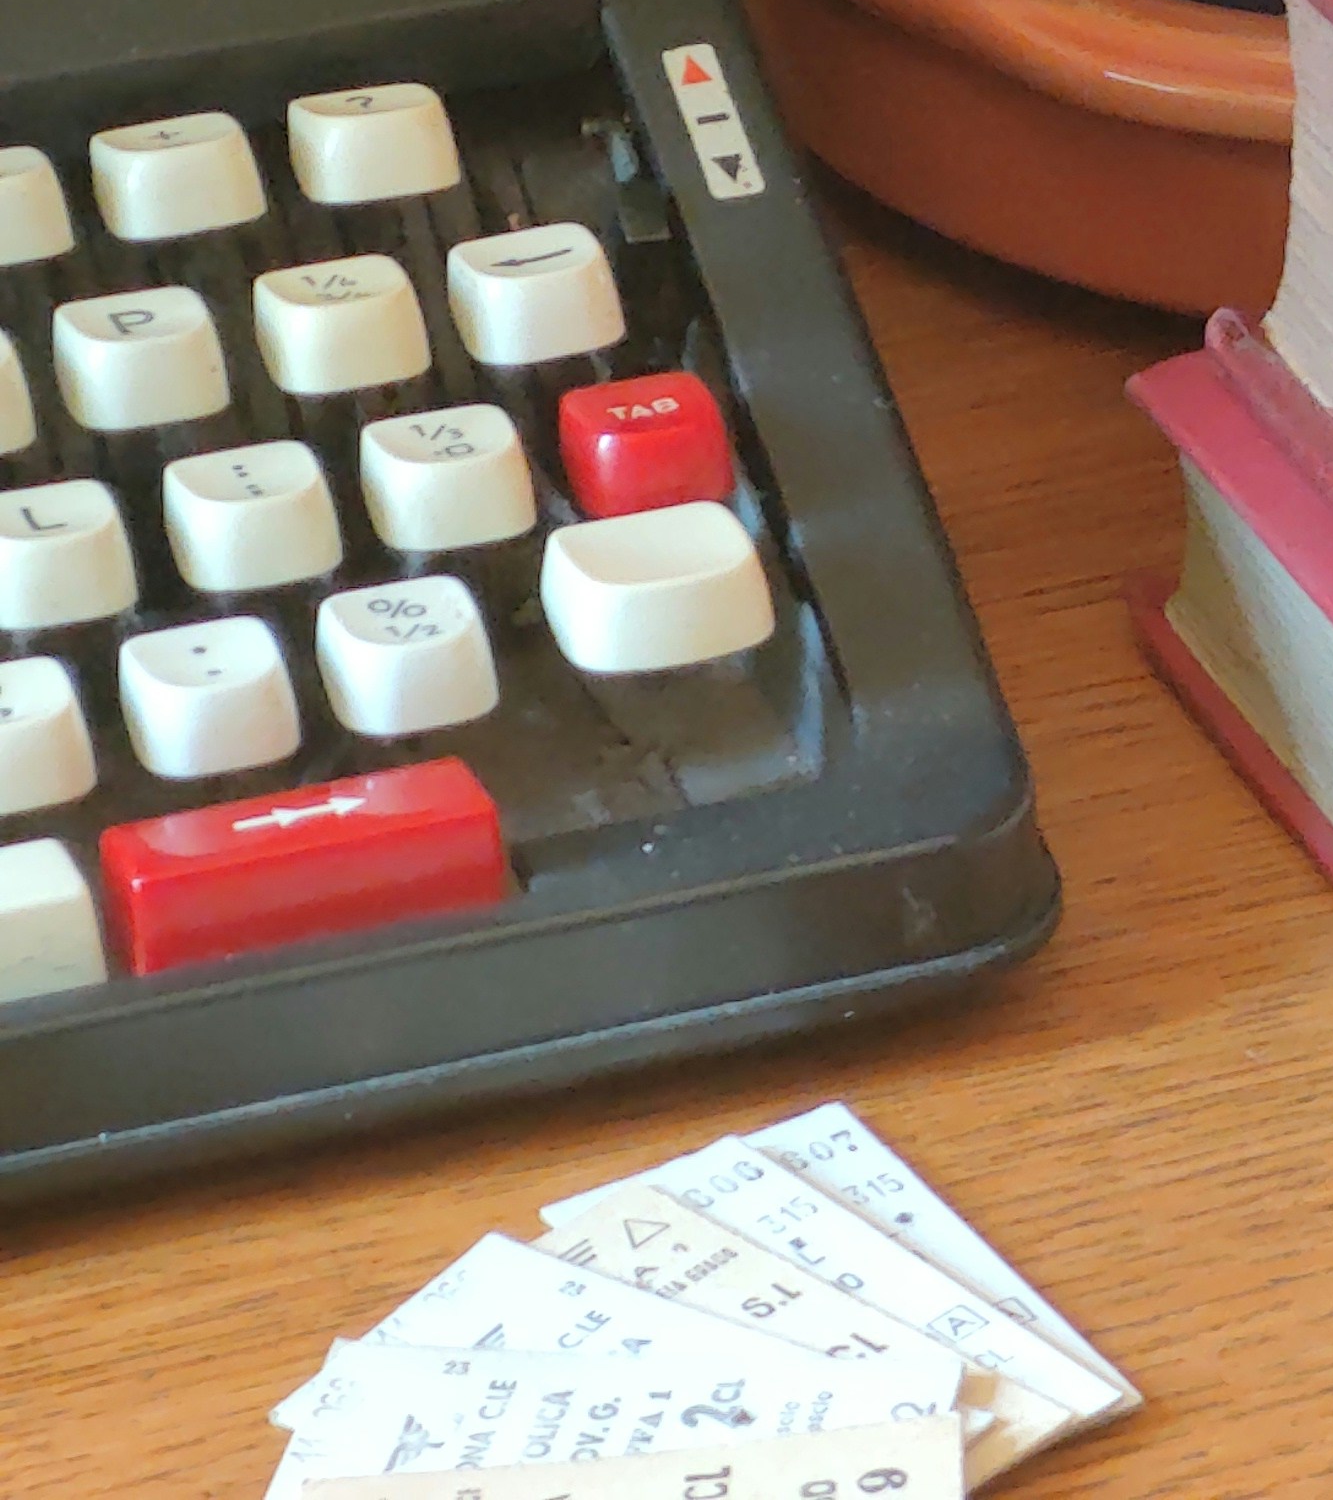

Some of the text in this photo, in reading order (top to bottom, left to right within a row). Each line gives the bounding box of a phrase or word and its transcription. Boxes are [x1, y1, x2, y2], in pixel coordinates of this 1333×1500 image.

[107, 308, 154, 337] P
[606, 397, 680, 420] TAB
[20, 505, 69, 531] L
